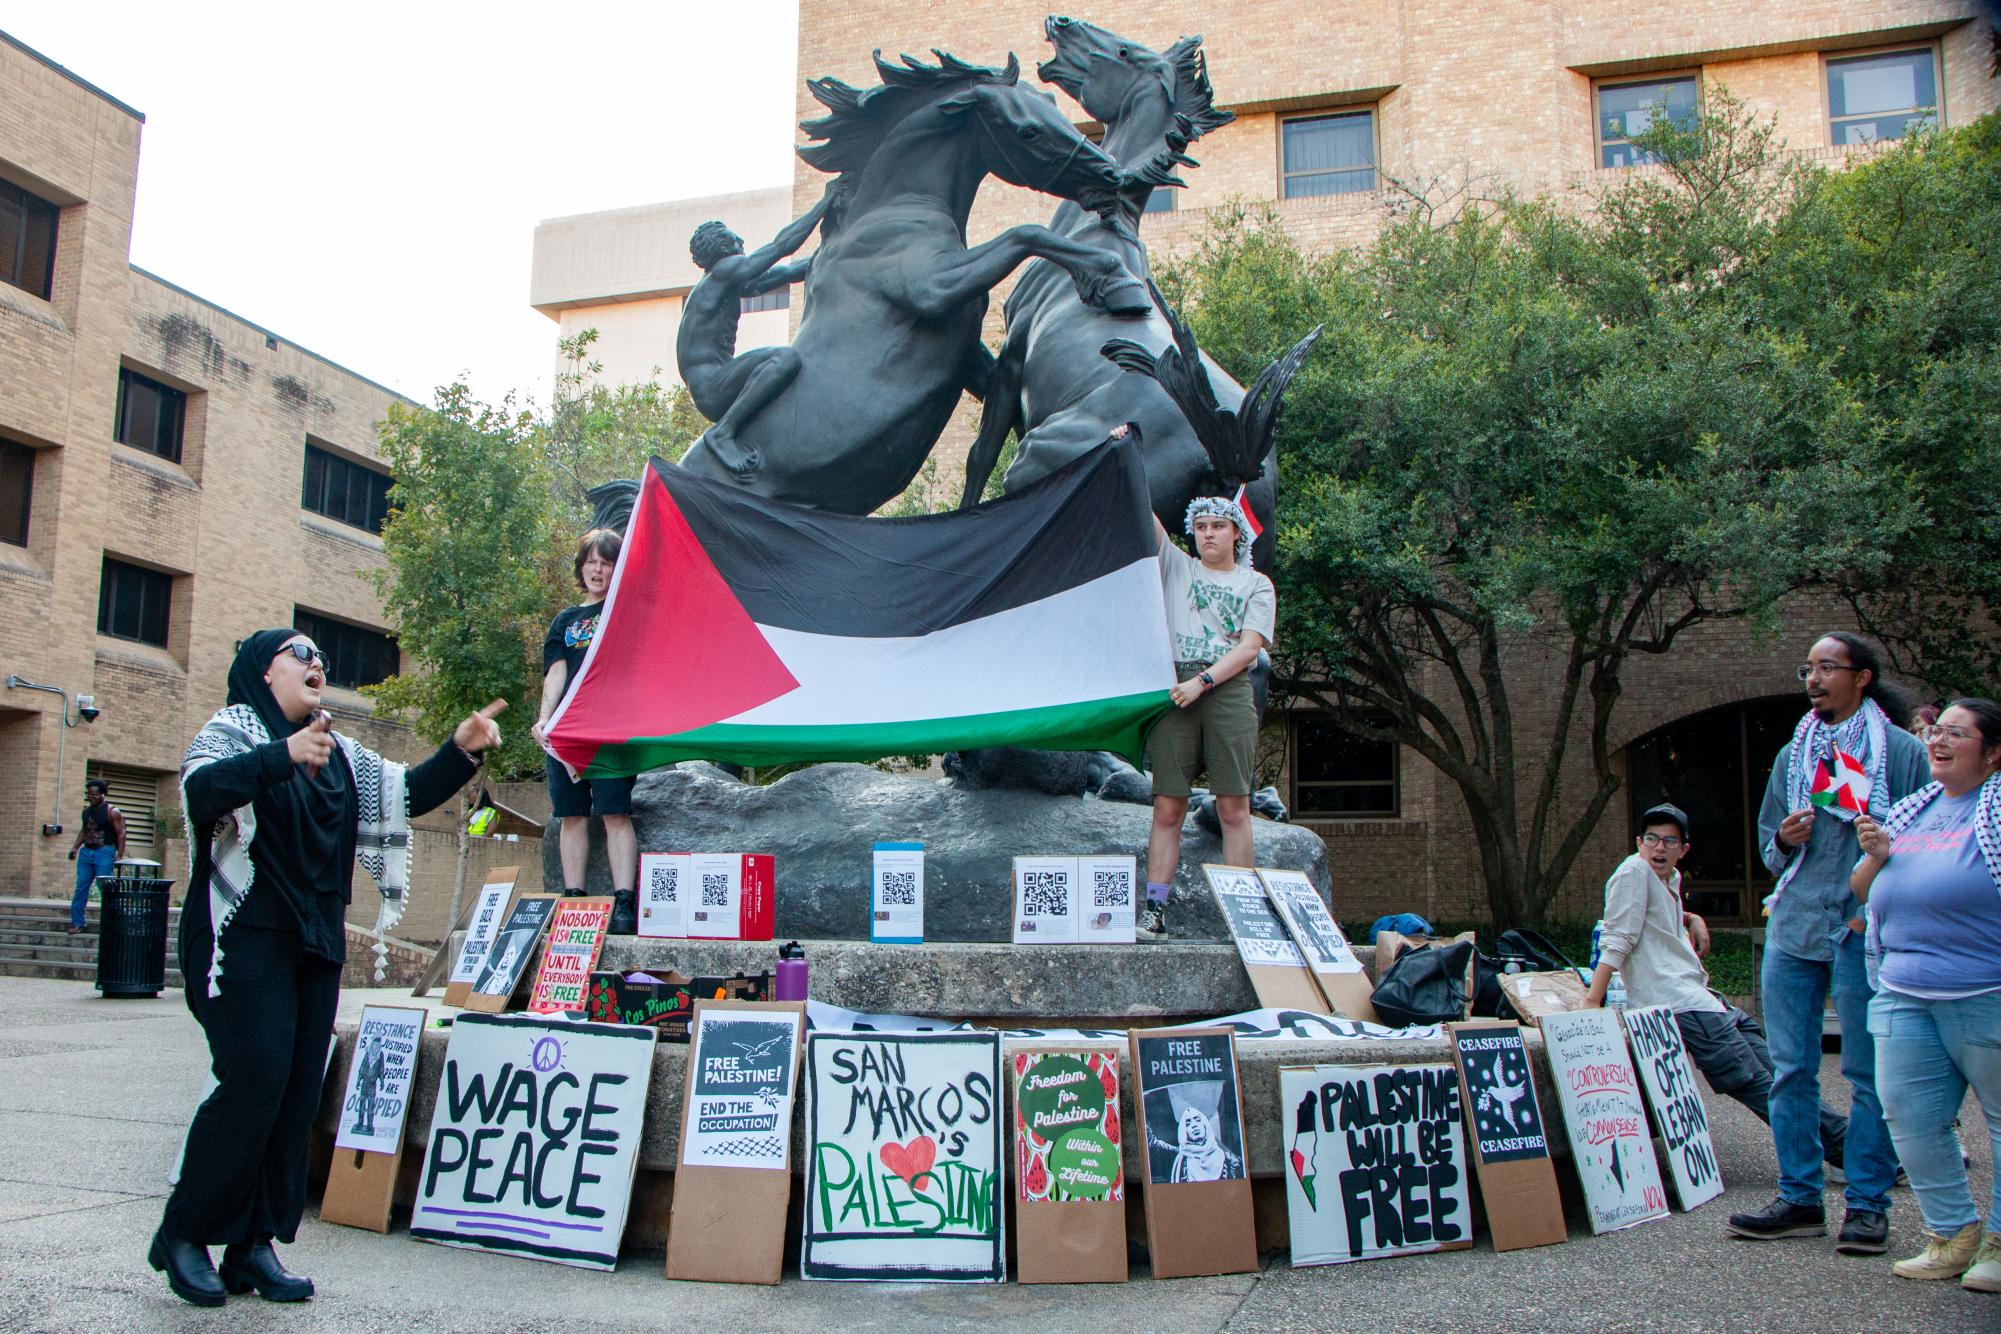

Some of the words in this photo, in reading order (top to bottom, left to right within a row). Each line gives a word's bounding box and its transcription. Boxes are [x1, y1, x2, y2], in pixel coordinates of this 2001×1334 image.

[526, 901, 542, 912] FREE
[512, 913, 543, 924] PALESTINE
[559, 912, 602, 928] NOBODY
[554, 929, 564, 942] IS
[568, 929, 597, 944] FREE
[548, 955, 581, 970] UNTIL
[543, 972, 585, 984] EVERYBODY
[538, 984, 548, 998] IS
[553, 986, 581, 1001] FREE
[625, 1009, 644, 1025] Los
[645, 997, 679, 1016] Pinos
[362, 1020, 417, 1040] RESISTANCE
[1626, 1008, 1682, 1060] HANDS
[359, 1037, 367, 1049] IS
[381, 1039, 413, 1054] JUSTIFIED
[1168, 1041, 1202, 1057] FREE
[1458, 1036, 1522, 1052] CEASEFIRE
[385, 1052, 405, 1066] WHEN
[705, 1057, 740, 1071] FREE
[829, 1042, 906, 1085] SAN
[1151, 1057, 1223, 1076] PALESTINE
[384, 1067, 409, 1080] PEOPLE
[704, 1065, 782, 1084] PALESTINE!
[1026, 1070, 1087, 1091] Freedom
[1655, 1049, 1694, 1099] OFF!
[385, 1083, 400, 1095] ARE
[447, 1059, 629, 1141] WAGE
[843, 1072, 992, 1141] MARCOS
[1057, 1090, 1078, 1108] for
[1320, 1068, 1461, 1132] PALESTINE
[700, 1101, 727, 1116] END
[728, 1101, 754, 1114] THE
[1033, 1106, 1099, 1128] Palestine
[700, 1113, 779, 1131] OCCUPATION!
[1657, 1091, 1709, 1151] LEBAN
[1066, 1138, 1103, 1153] Within
[1346, 1124, 1416, 1169] WILL
[1417, 1119, 1453, 1166] BE
[1480, 1135, 1544, 1153] CEASEFIRE
[1080, 1157, 1099, 1167] our
[1684, 1139, 1719, 1188] ON!
[424, 1128, 618, 1219] PEACE
[1058, 1166, 1109, 1186] Lifetime
[816, 1142, 1001, 1235] PALESTINE
[1338, 1163, 1462, 1257] FREE
